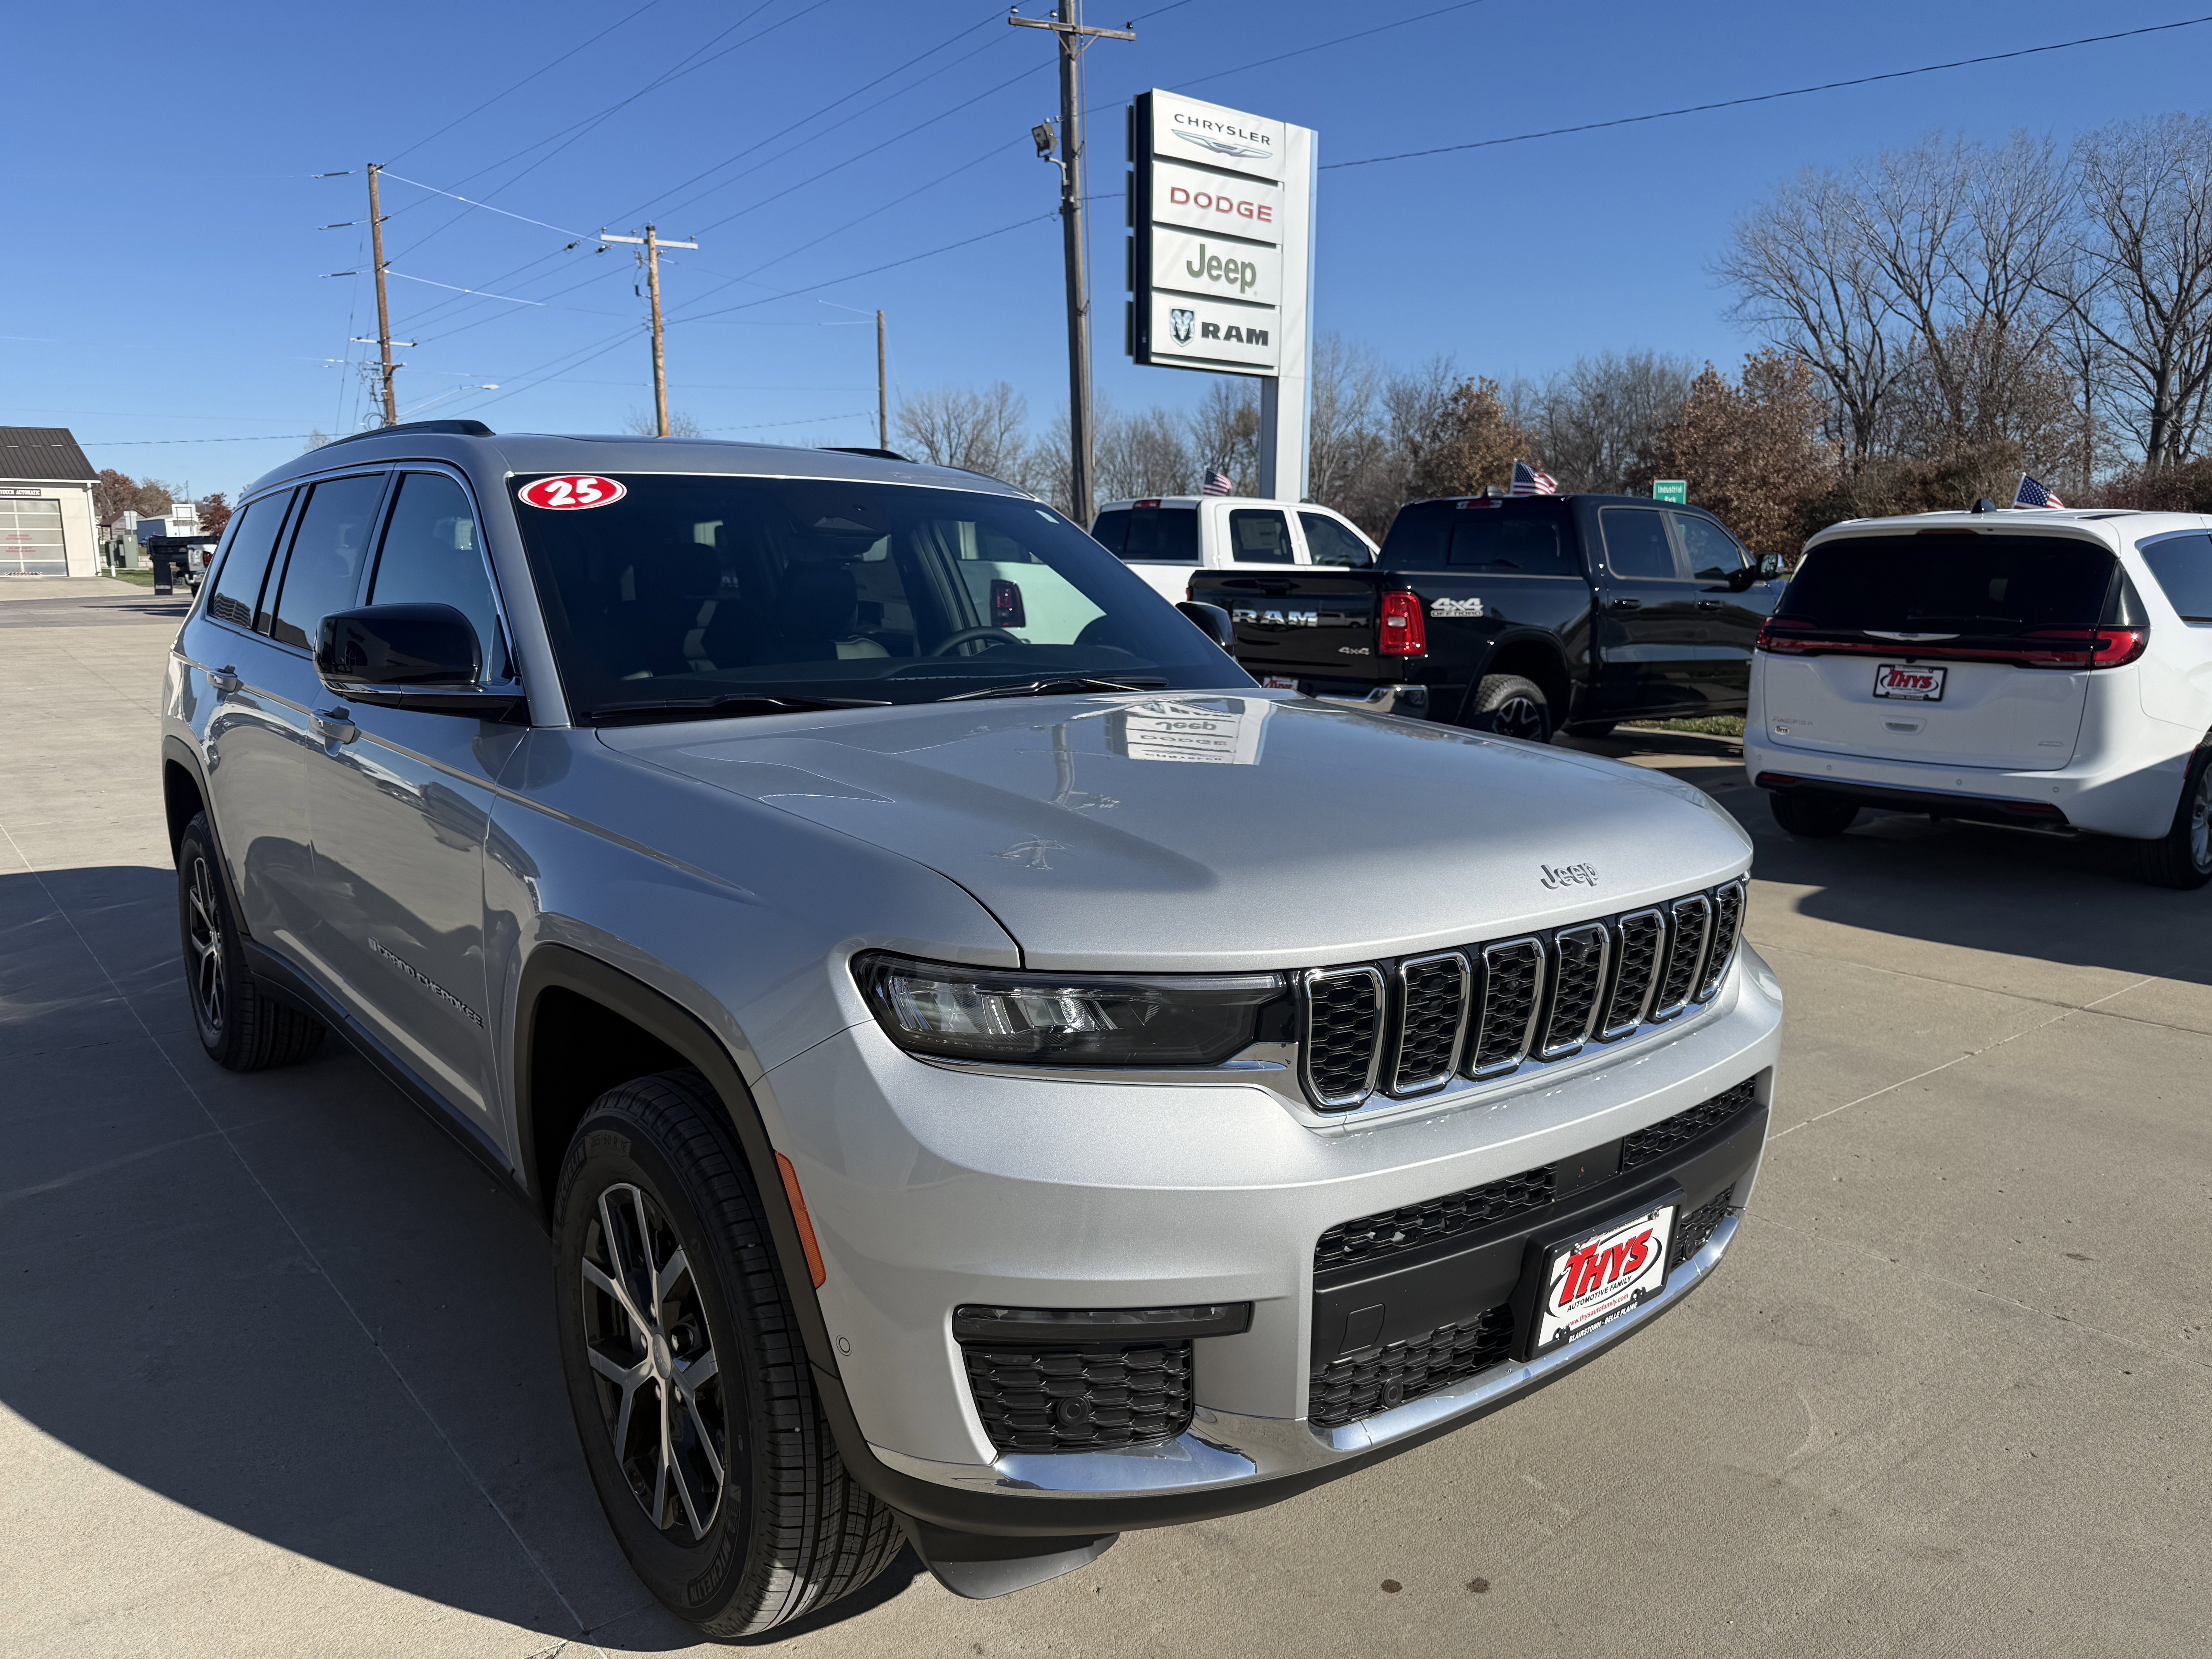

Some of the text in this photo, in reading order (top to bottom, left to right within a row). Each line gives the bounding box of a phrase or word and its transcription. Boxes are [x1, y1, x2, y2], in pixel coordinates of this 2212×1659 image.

[1174, 113, 1271, 146] CHRYSLER
[1170, 186, 1273, 223] DODGE
[1186, 243, 1256, 294] Jeep
[1201, 322, 1269, 347] RAM
[544, 478, 603, 506] 25
[1233, 609, 1317, 627] RAM
[1430, 598, 1484, 611] 4x4
[1338, 646, 1370, 655] 4x4
[1887, 670, 1933, 688] THYS
[1540, 863, 1599, 890] Jeep
[378, 944, 484, 1029] GRAND CHEROKEE
[555, 1143, 586, 1224] MICHELIN
[1558, 1227, 1654, 1307] THYS
[1566, 1293, 1628, 1327] www.thysautofamily.com
[1567, 1275, 1632, 1312] AUTOMOTIVE FAMILY
[1568, 1301, 1638, 1343] BLAIRSTOWN BELLE PLAINE
[690, 1531, 732, 1602] MICHELIN
